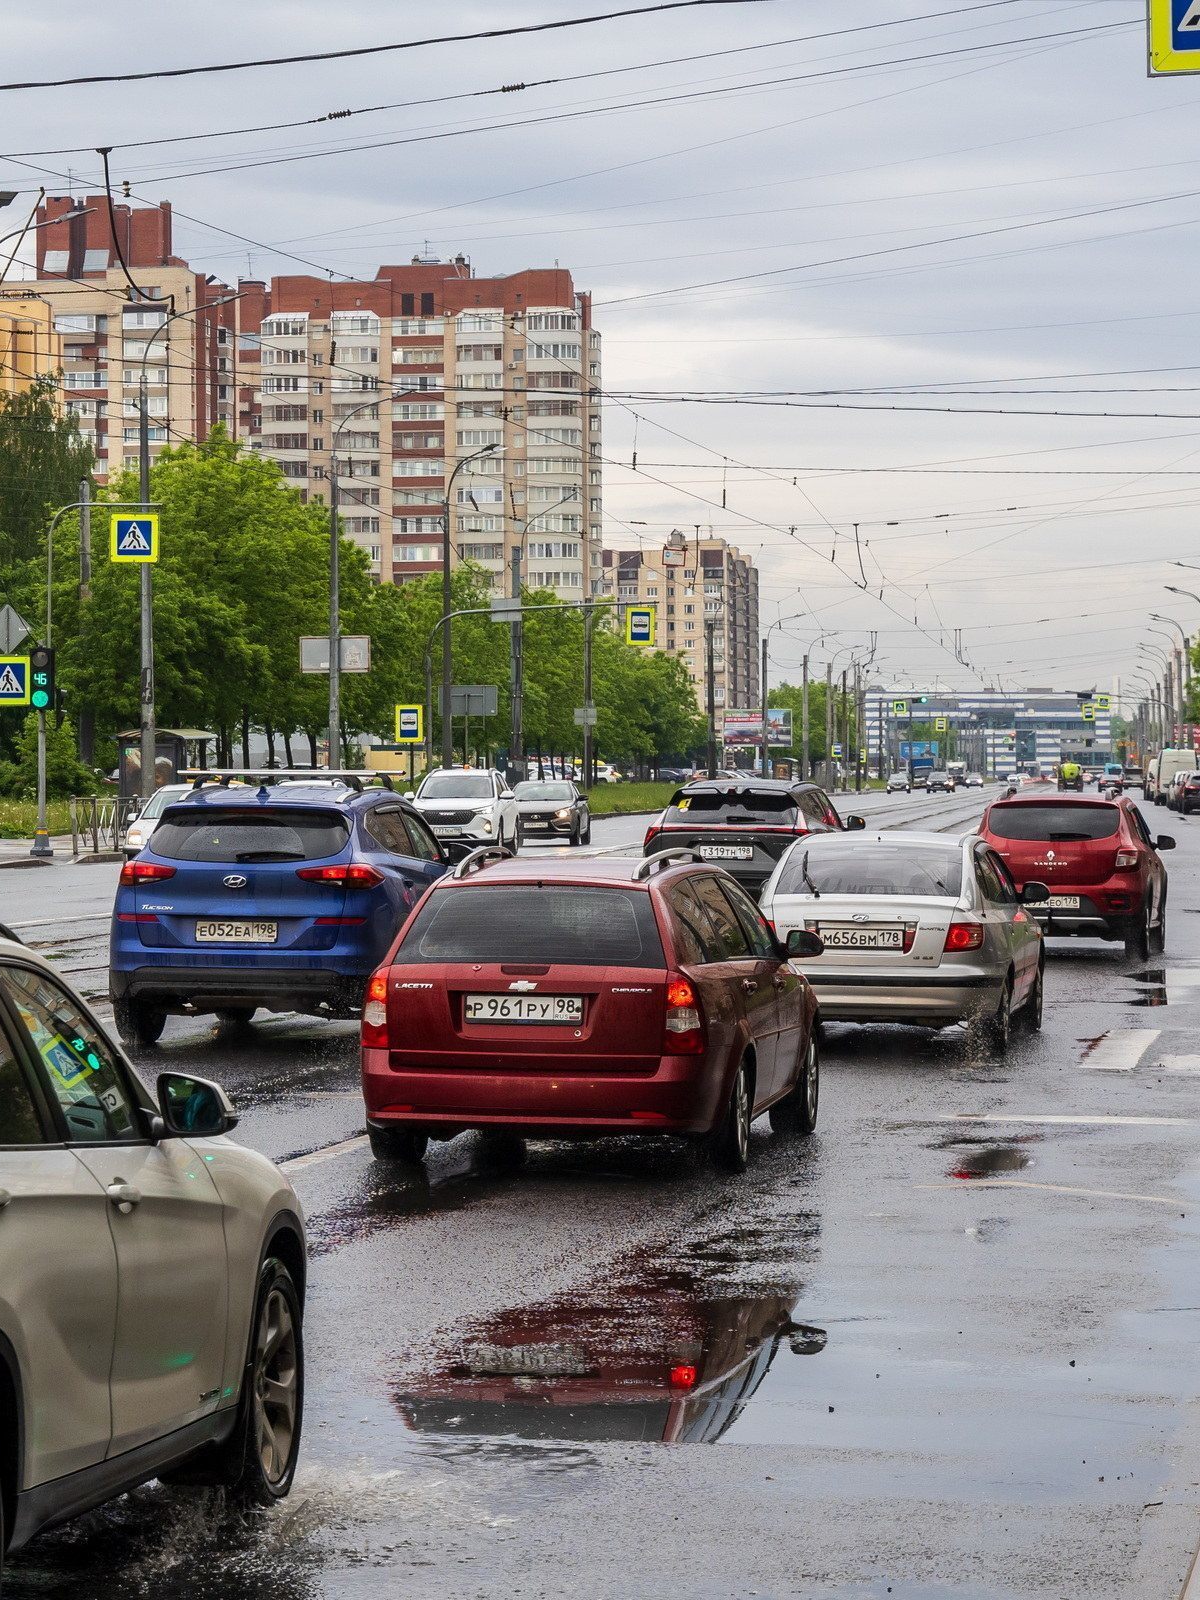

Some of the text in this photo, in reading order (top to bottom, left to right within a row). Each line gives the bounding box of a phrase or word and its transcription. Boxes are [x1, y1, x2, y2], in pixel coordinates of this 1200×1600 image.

[33, 673, 47, 685] 46
[198, 923, 273, 938] Е052ЕА 198
[823, 931, 900, 945] М656ВМ 178
[472, 998, 575, 1018] Р961РУ 98
